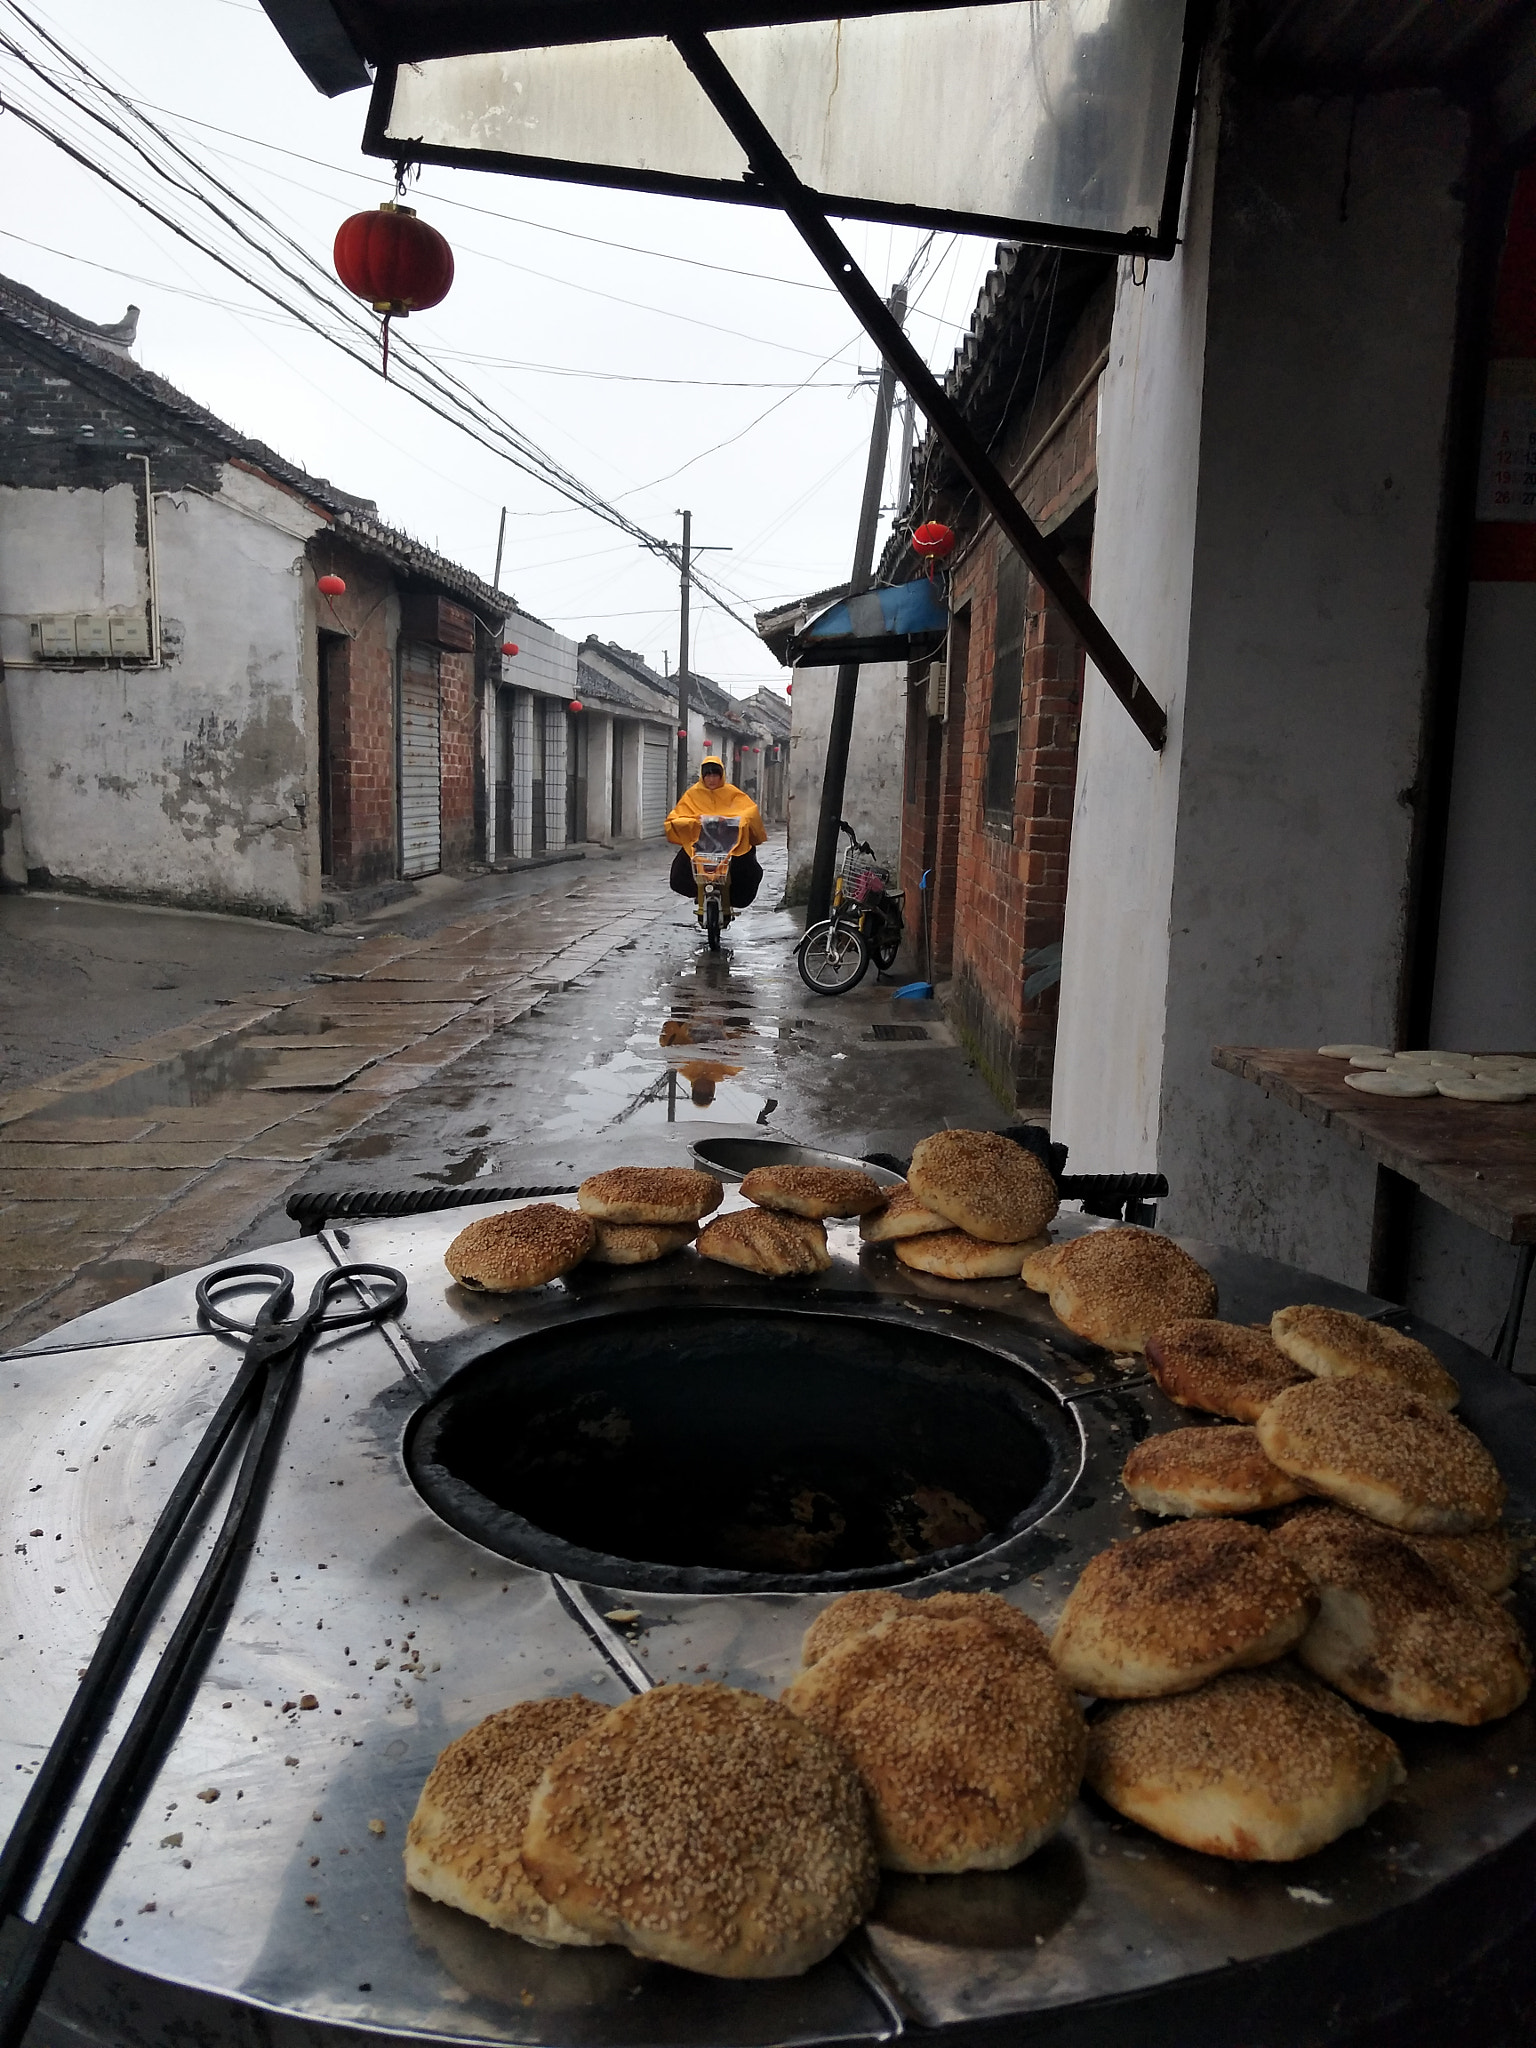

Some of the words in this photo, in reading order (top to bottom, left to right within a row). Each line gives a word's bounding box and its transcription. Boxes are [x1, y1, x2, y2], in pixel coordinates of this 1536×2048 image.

[1501, 430, 1510, 443] 5
[1497, 451, 1512, 464] 12
[1496, 471, 1511, 484] 19
[1495, 491, 1510, 504] 26
[1522, 492, 1536, 505] 27
